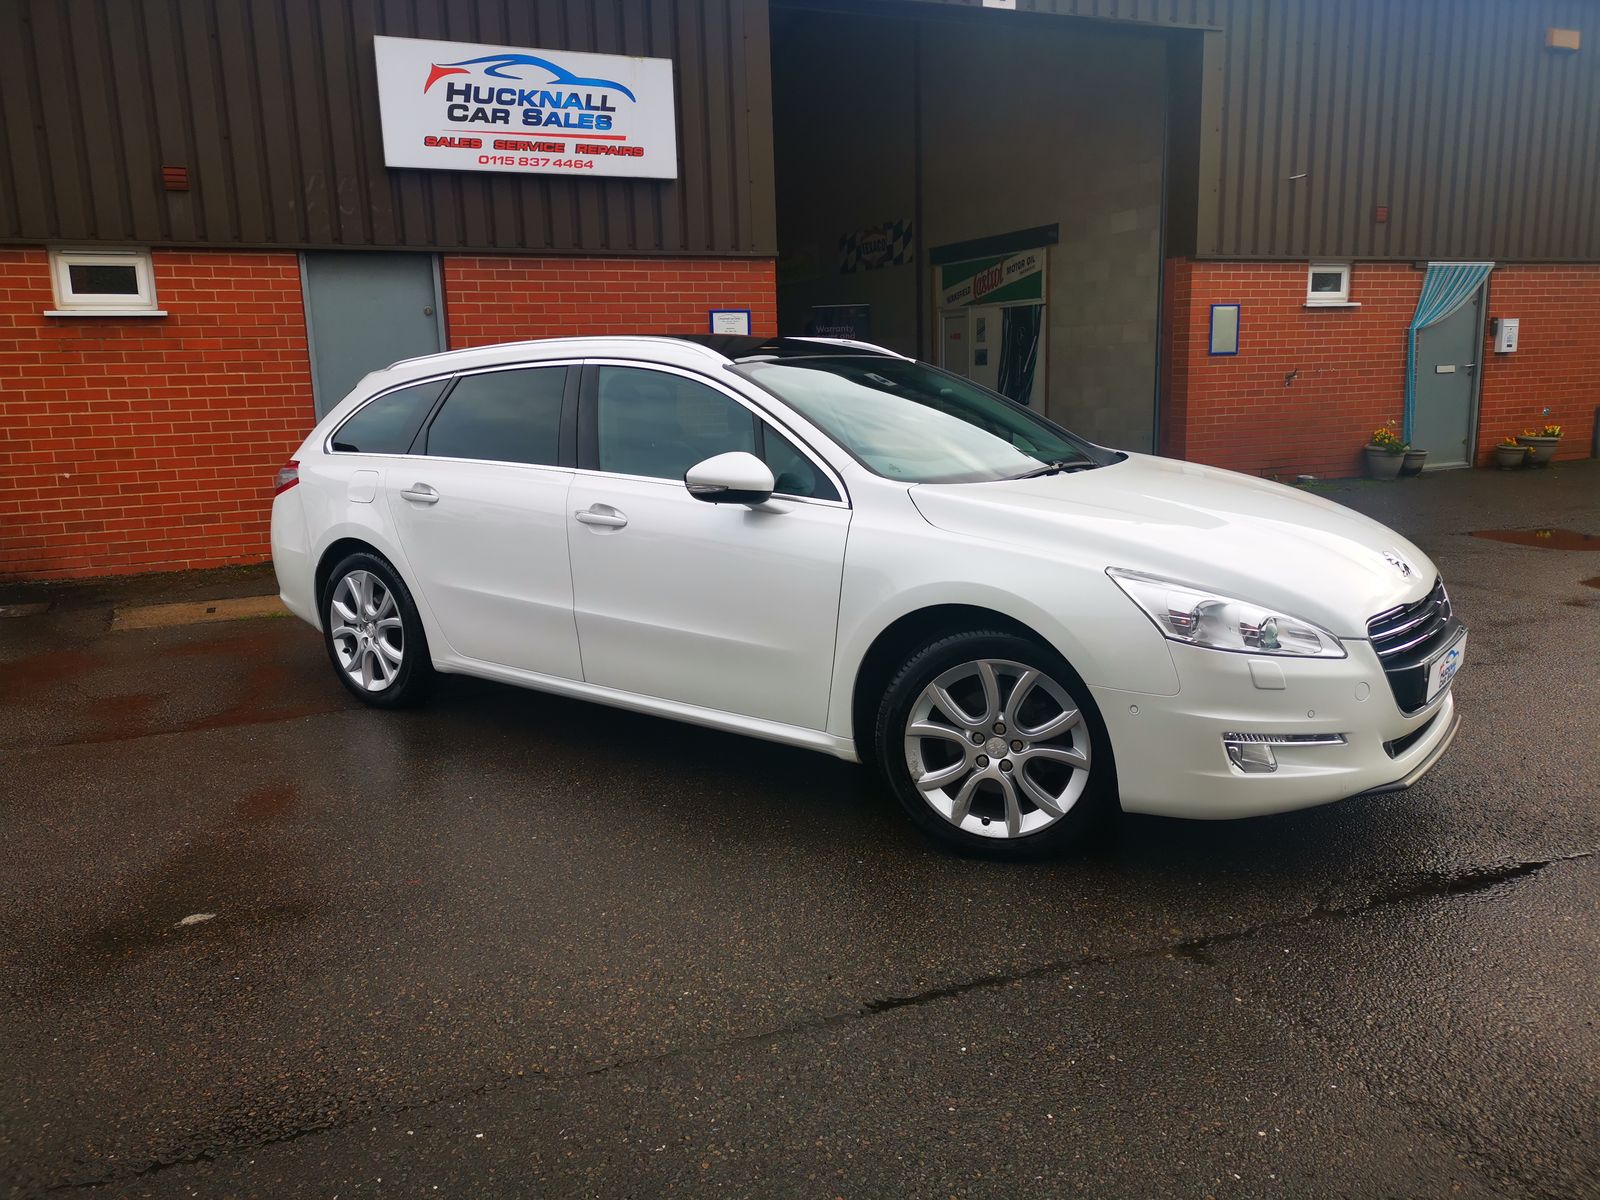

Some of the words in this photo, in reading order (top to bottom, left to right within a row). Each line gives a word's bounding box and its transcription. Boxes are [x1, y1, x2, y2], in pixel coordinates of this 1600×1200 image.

[446, 82, 616, 112] HUCKNALL
[447, 103, 511, 124] CAR
[522, 109, 612, 130] SALES
[424, 135, 483, 150] SALES
[493, 139, 565, 153] SERVICE
[575, 143, 645, 157] REPAIRS
[478, 155, 515, 166] 0115
[518, 157, 551, 168] 837
[552, 159, 594, 169] 4464
[973, 260, 1004, 303] Castrol
[1007, 259, 1026, 275] MOTOR
[1027, 255, 1036, 268] OIL
[815, 325, 854, 334] Warranty
